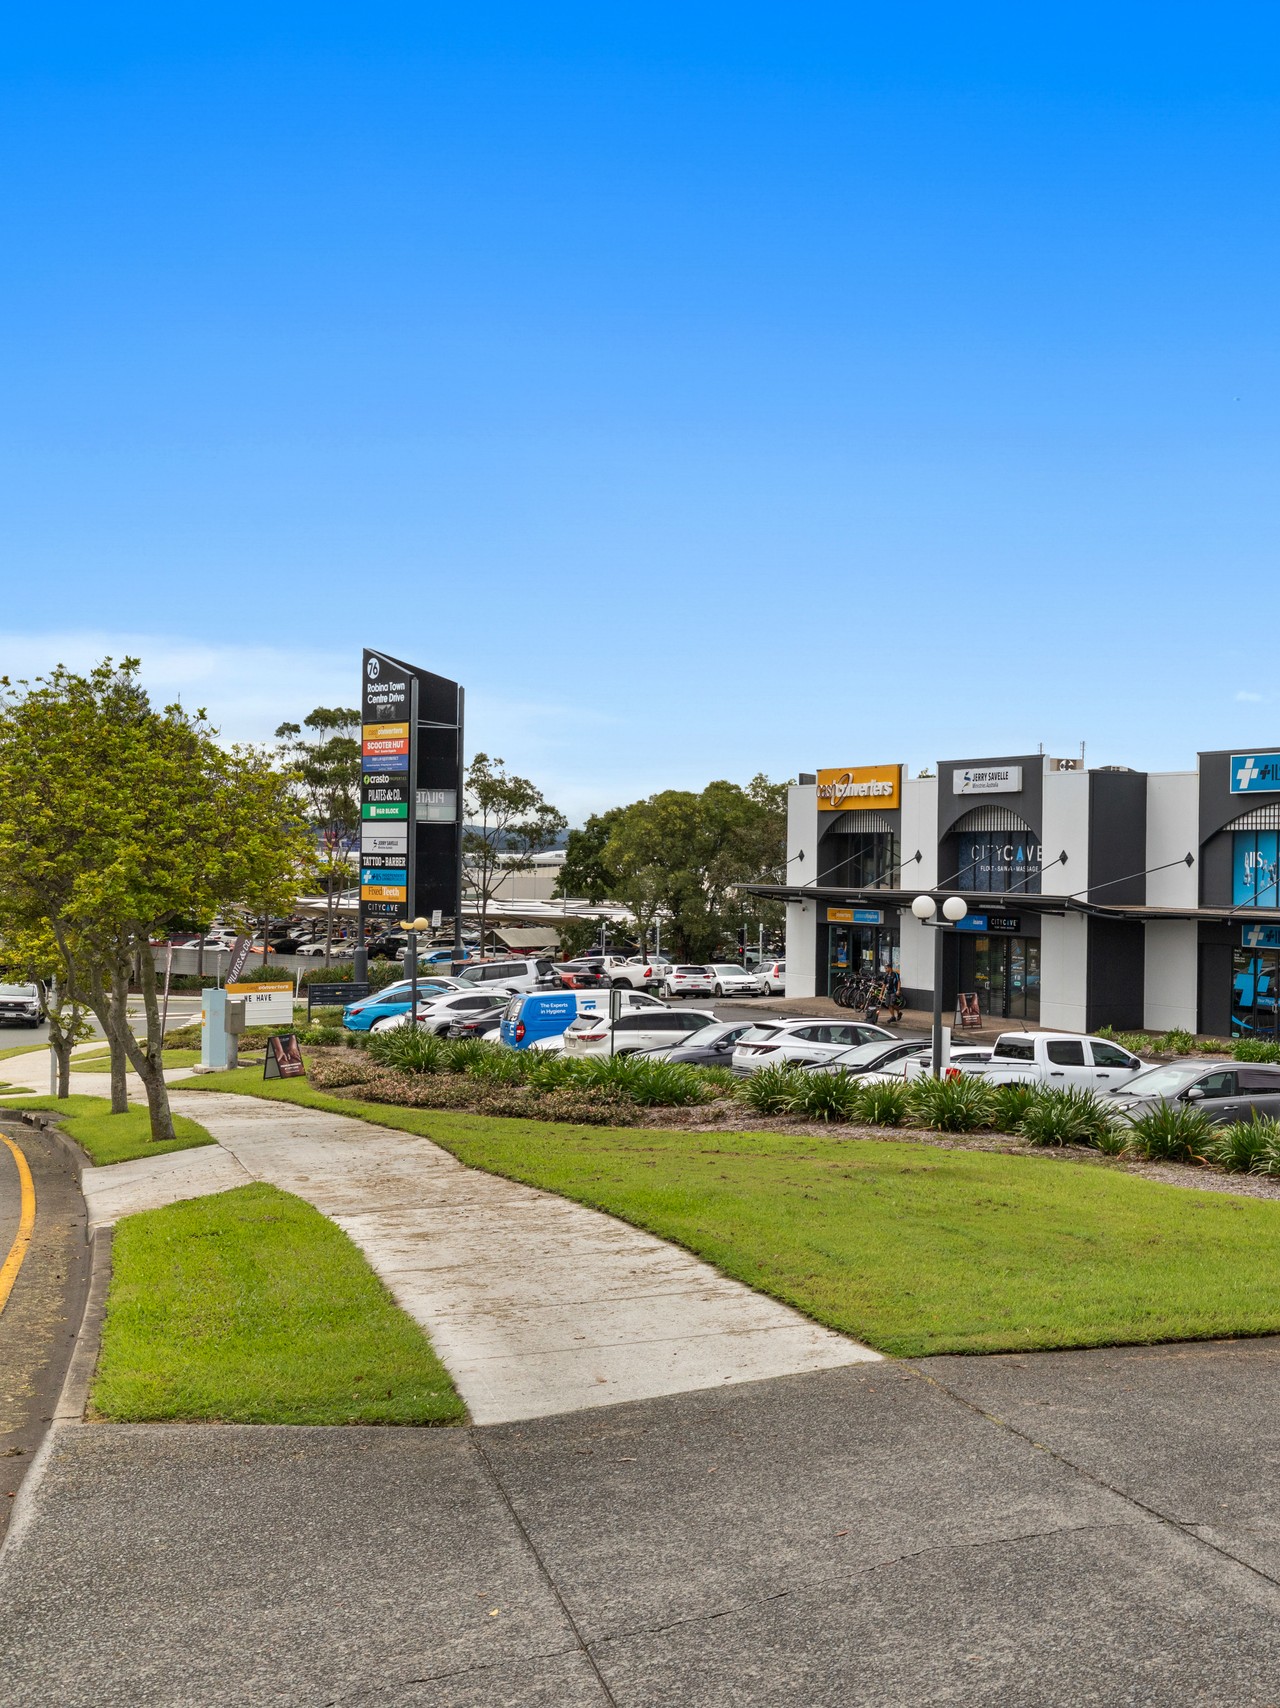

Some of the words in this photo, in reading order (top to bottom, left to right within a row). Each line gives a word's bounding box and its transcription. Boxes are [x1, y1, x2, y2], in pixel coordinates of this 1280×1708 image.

[369, 662, 378, 675] 76
[368, 684, 388, 692] Robina
[390, 682, 405, 690] Town
[368, 695, 388, 704] Centre
[389, 694, 404, 702] Drive
[973, 773, 987, 781] JERRY
[988, 772, 1008, 780] SAVELLE
[368, 789, 386, 801] PILATES
[387, 789, 392, 800] &
[393, 789, 401, 800] CO.
[369, 887, 382, 895] Fixed
[383, 887, 399, 896] Teeth
[227, 958, 242, 984] PILATES
[240, 951, 246, 960] &
